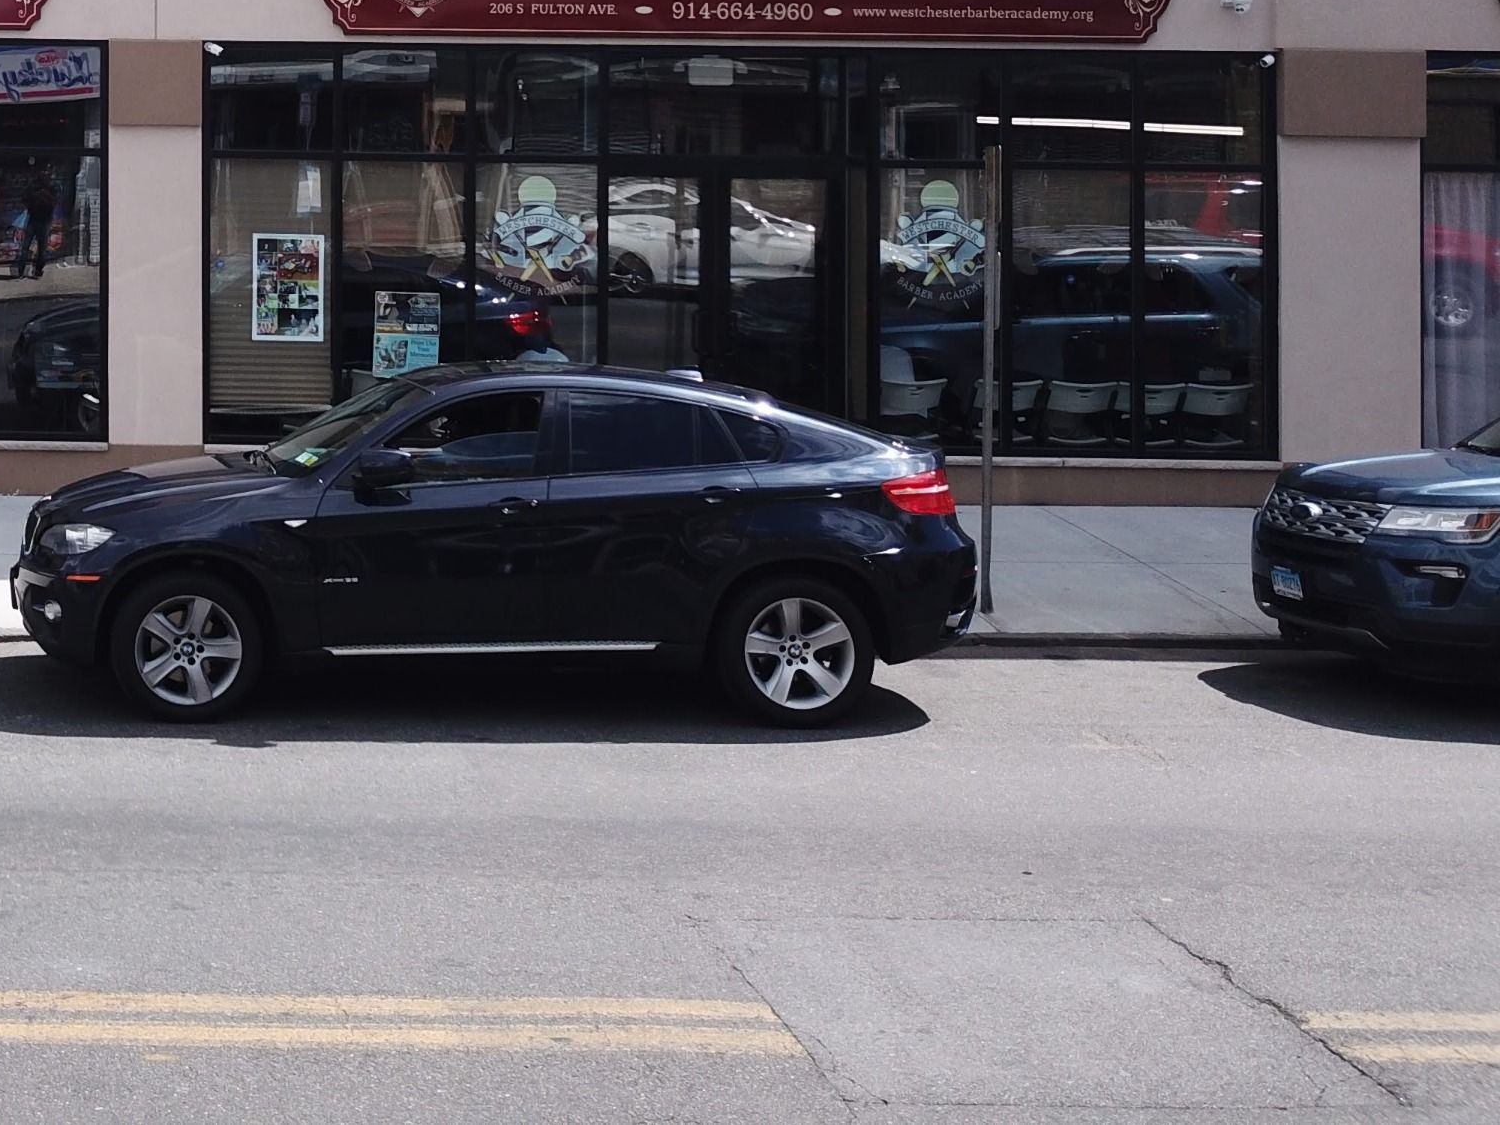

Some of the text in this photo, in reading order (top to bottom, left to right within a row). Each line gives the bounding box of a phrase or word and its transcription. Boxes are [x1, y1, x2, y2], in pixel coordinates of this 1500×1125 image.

[489, 3, 513, 14] 206
[516, 3, 525, 14] S
[531, 3, 585, 15] FULTON
[672, 2, 813, 21] 914-664-4960
[498, 216, 576, 238] WESTCHESTER
[901, 220, 979, 243] WESTCHESTER
[495, 272, 581, 296] BARBER ACADEMY
[897, 276, 982, 300] BARBER ACADEMY
